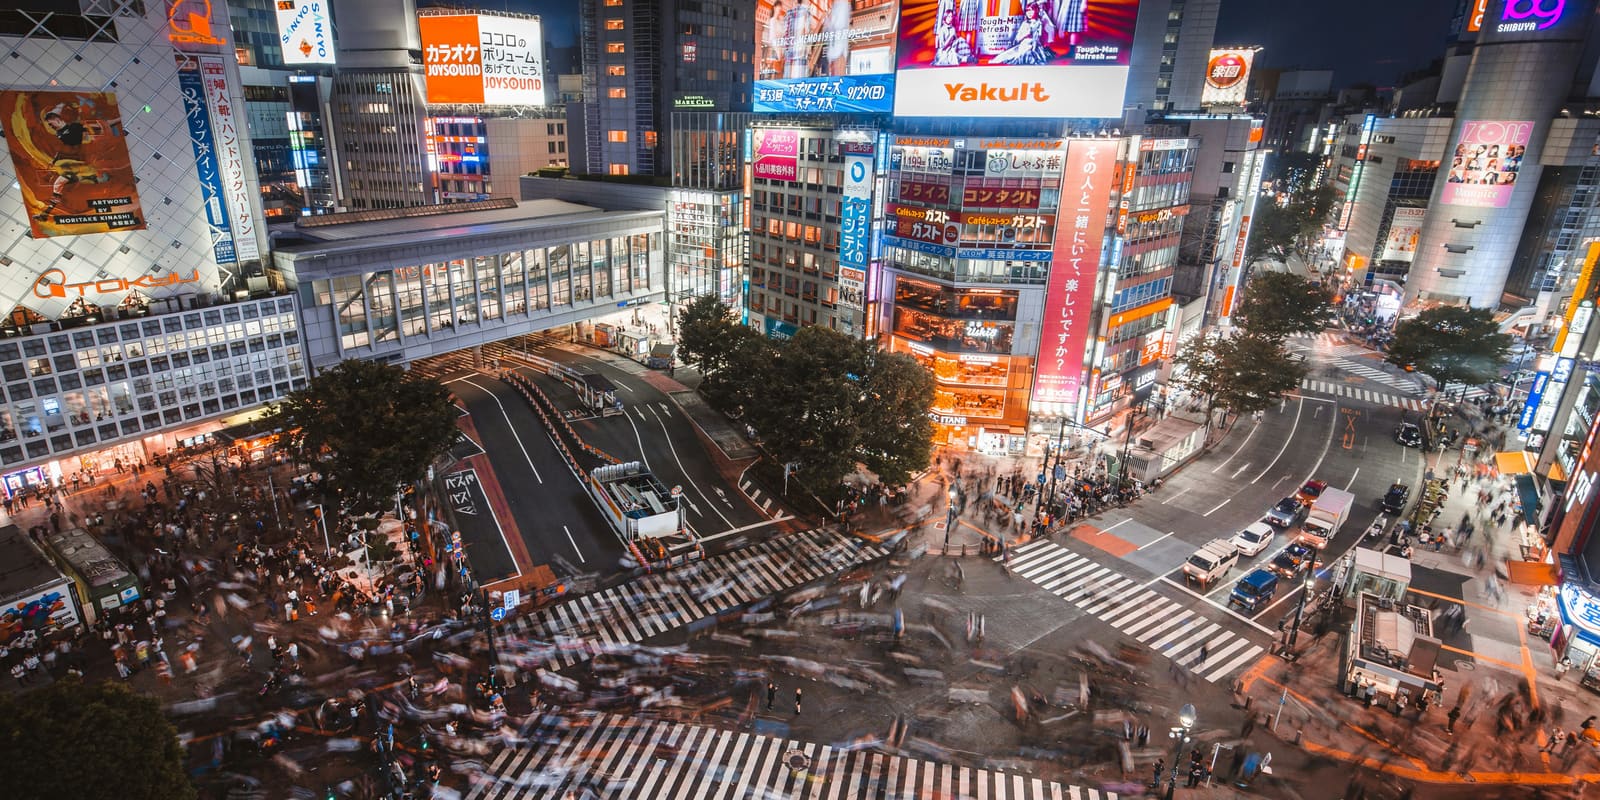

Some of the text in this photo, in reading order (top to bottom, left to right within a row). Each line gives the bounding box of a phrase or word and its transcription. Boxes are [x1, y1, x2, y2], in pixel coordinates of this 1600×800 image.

[282, 5, 309, 44] SANKYO
[311, 2, 326, 58] SANKYO
[1497, 22, 1536, 32] SHIBUYA
[481, 31, 527, 48] ココロの
[426, 43, 479, 63] カラオケ
[483, 47, 540, 65] ボリューム、
[428, 63, 481, 77] JOYSOUND
[484, 63, 541, 76] あげていこう。
[485, 76, 542, 91] JOYSOUND
[847, 83, 886, 100] 9/29(日)
[944, 82, 1050, 103] Yakult
[892, 153, 902, 162] 9F
[1012, 155, 1061, 170] しゃぶ葉
[964, 189, 1037, 205] コンタクト
[59, 216, 98, 224] NORITAKE
[925, 209, 950, 224] ガスト
[1011, 215, 1047, 228] ガスト
[886, 219, 898, 230] 7F
[911, 222, 942, 240] ガスト
[987, 250, 1050, 260] 英会話イーオン
[1056, 146, 1099, 371] その人と一緒にいて、楽しいですか？
[65, 270, 200, 296] TOKYU
